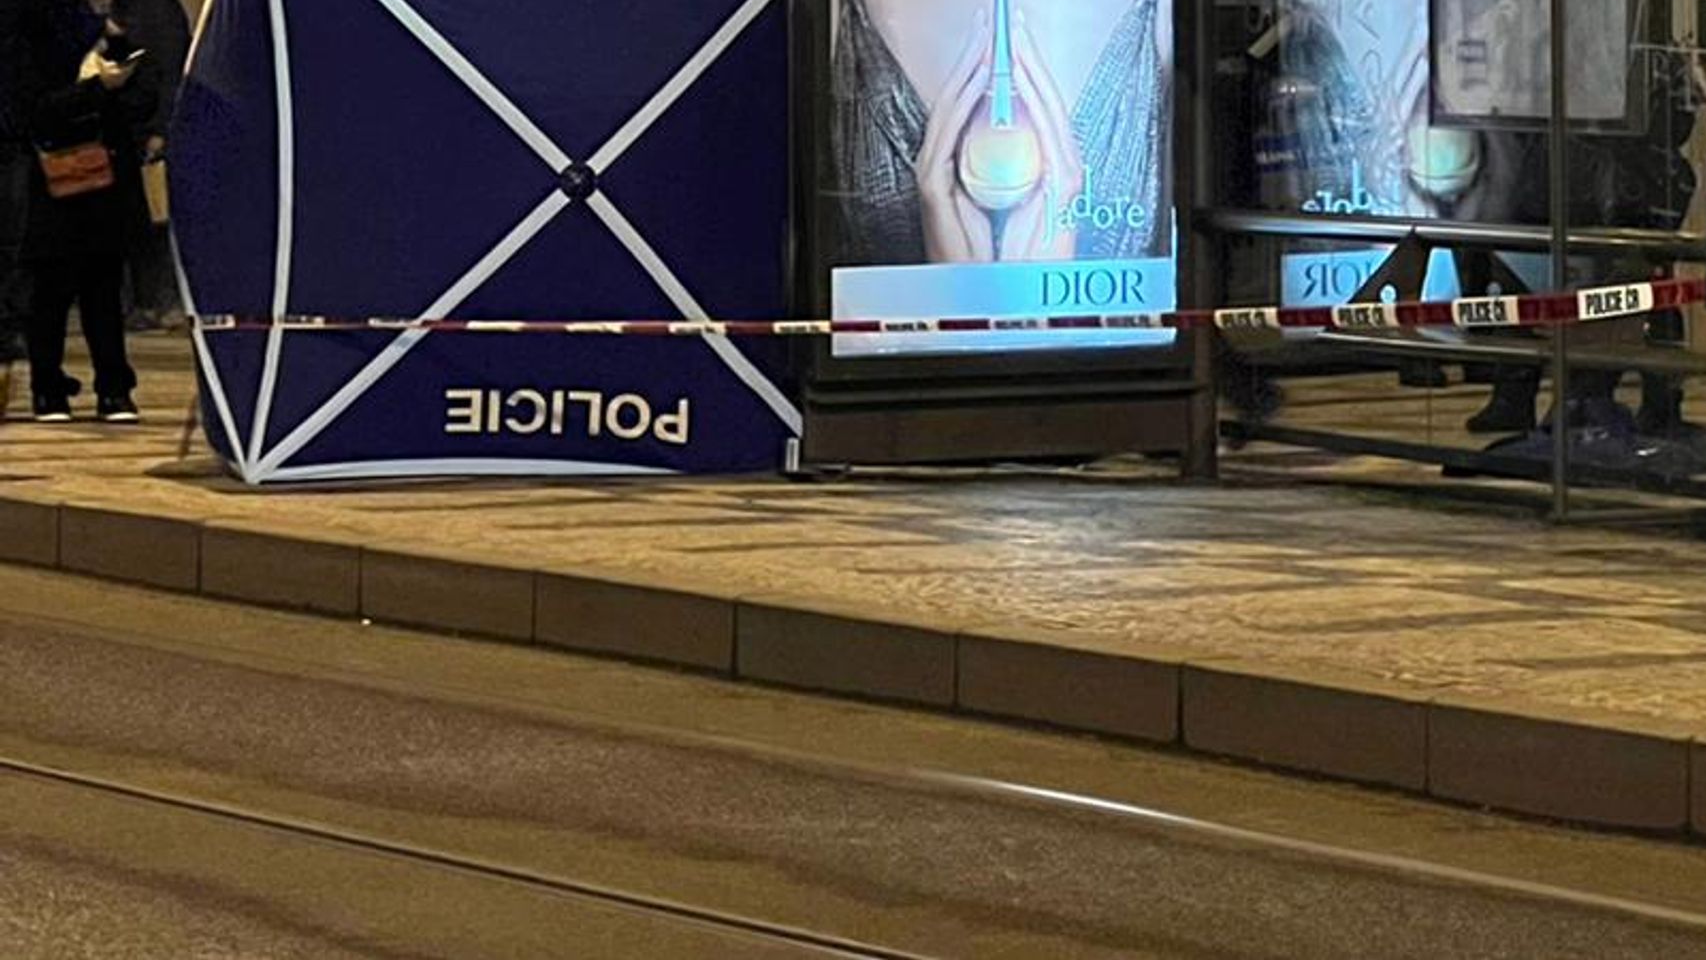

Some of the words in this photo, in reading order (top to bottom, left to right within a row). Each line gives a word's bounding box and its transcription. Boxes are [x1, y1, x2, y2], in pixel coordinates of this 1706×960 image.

[1041, 268, 1145, 307] DIOR
[1585, 290, 1622, 315] POLICIE
[444, 388, 690, 444] POLICIE
